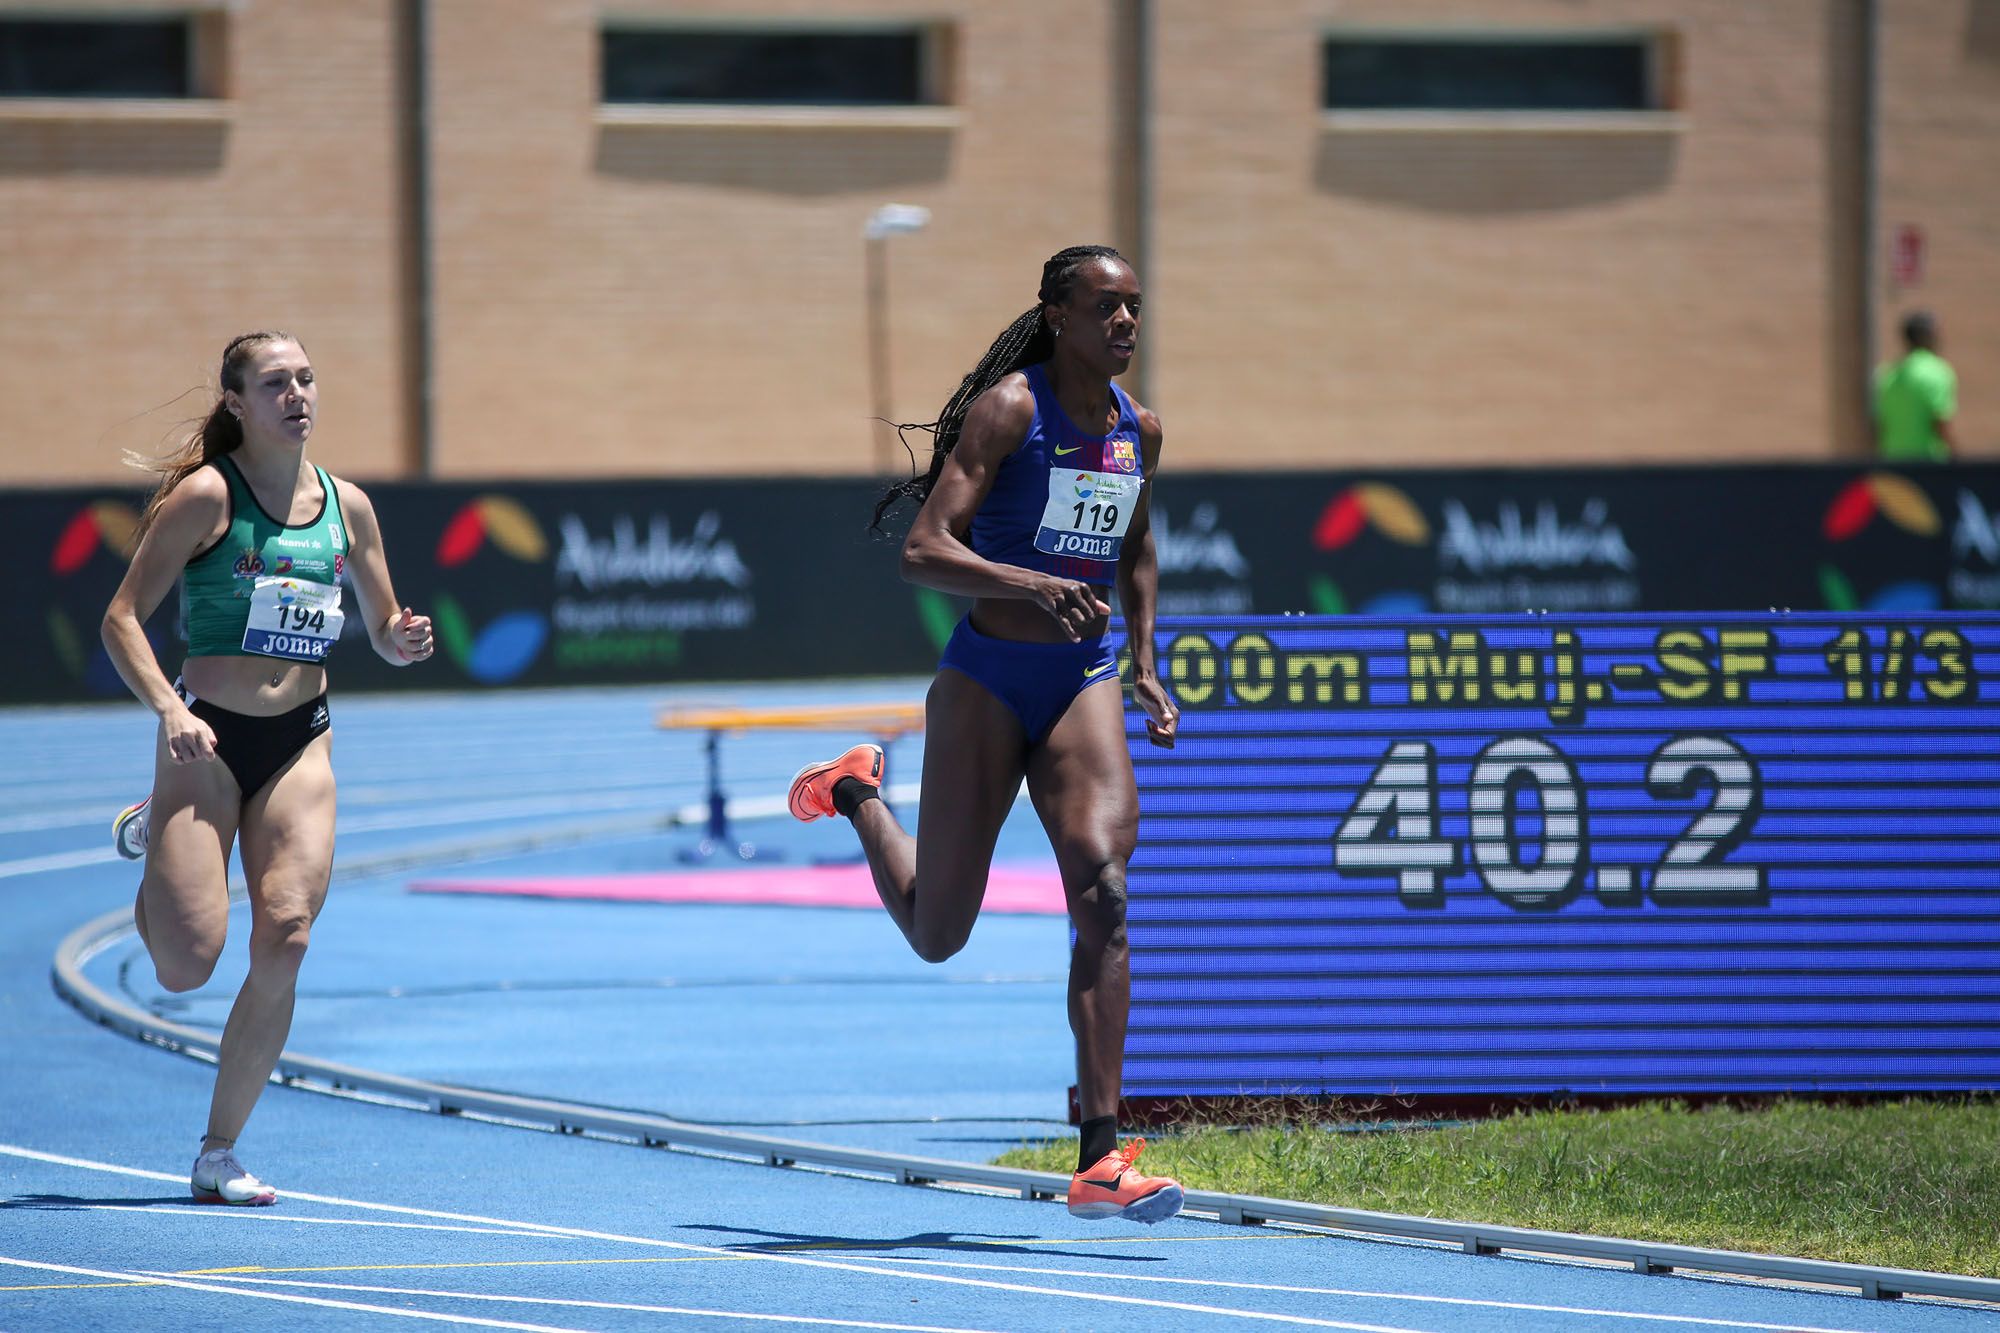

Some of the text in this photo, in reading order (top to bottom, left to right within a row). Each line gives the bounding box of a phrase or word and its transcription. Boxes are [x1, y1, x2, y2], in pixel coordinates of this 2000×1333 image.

[1073, 501, 1119, 533] 119
[277, 606, 325, 634] 194
[1407, 630, 1768, 717] Muj.-SF
[1826, 630, 1966, 699] 1/3
[1335, 736, 1760, 902] 40.2
